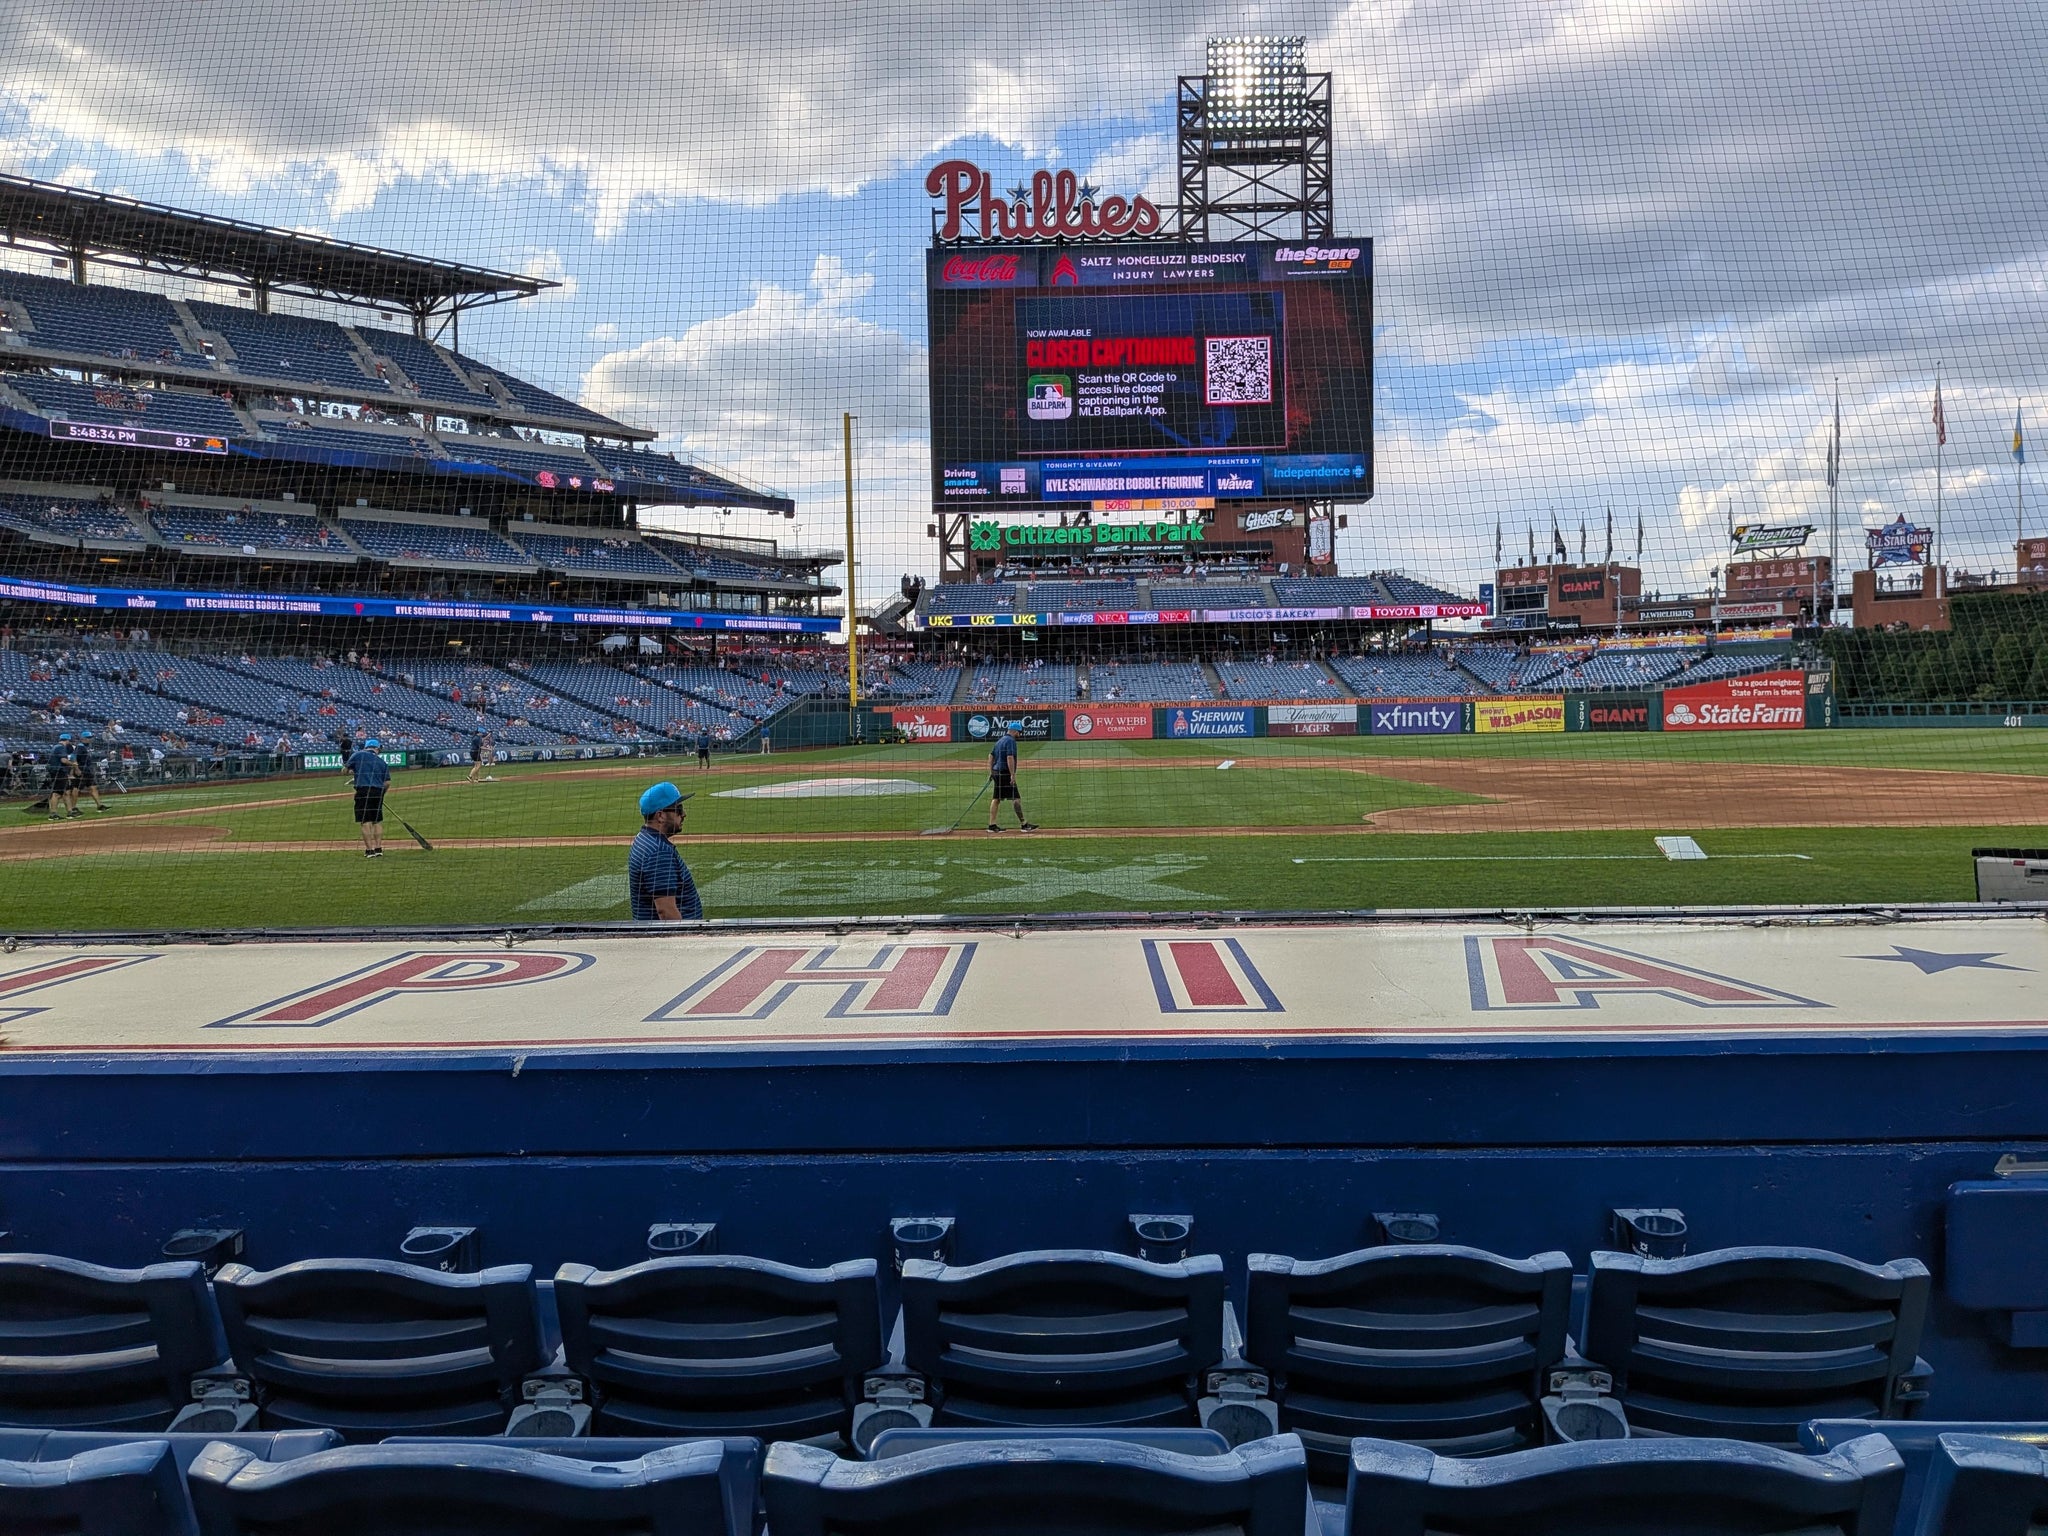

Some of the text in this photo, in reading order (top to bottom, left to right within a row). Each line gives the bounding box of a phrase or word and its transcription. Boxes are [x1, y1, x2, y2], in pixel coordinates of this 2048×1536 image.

[925, 159, 1161, 241] Phillies
[1275, 247, 1360, 261] theScore
[1080, 254, 1247, 266] SALTZ MONGELUZZI BENDESKY
[1112, 269, 1215, 280] INJURY LAWYERS
[1048, 329, 1091, 337] AVAILABLE
[1027, 337, 1196, 367] CLOSED CAPTIONING
[1078, 373, 1177, 383] Scan the QR Code to
[1113, 385, 1130, 394] live
[1132, 384, 1164, 393] closed
[1031, 401, 1067, 410] BALLPARK
[1078, 395, 1159, 408] captioning in the
[1079, 406, 1167, 417] MLB Ballpark App.
[70, 426, 116, 440] 5:48:34
[118, 431, 136, 442] PM
[944, 469, 976, 480] Driving
[1274, 467, 1350, 480] Independence
[944, 478, 979, 486] smarter
[1046, 476, 1204, 492] KYLE SCHWARBER BOBBLE FIGURINE
[1218, 477, 1254, 490] Wawa
[944, 487, 991, 495] outcomes.
[1246, 510, 1284, 531] GHOST
[1005, 520, 1204, 544] Citizens Bank Park
[1867, 534, 1931, 547] ALL STAR GAME
[1562, 581, 1600, 592] GIANT
[186, 598, 320, 612] KYLE SCHWARBER BOBBLE FIGURINE
[1441, 606, 1482, 615] TOYOTA
[396, 606, 510, 618] KYLE SCHWARBER BOBBLE FIGURINE
[1162, 612, 1189, 622] NECA
[1230, 610, 1316, 620] LISCIO'S BAKERY
[1374, 608, 1416, 616] TOYOTA
[574, 614, 588, 622] KYLE
[590, 614, 624, 622] SCHWARBER
[928, 616, 952, 626] UKG
[971, 615, 994, 625] UKG
[1013, 614, 1036, 624] UKG
[1097, 614, 1125, 622] NECA
[1556, 622, 1579, 630] Fanatics
[1751, 680, 1768, 688] good
[1808, 673, 1830, 695] MONTY'S ANGLE
[1732, 689, 1750, 697] State
[1190, 711, 1244, 722] SHERWIN
[1285, 706, 1340, 723] Yuengling
[1377, 706, 1456, 731] xfinity
[1590, 708, 1647, 723] GIANT
[1096, 717, 1146, 726] F.W. WEBB
[2004, 716, 2022, 727] 401
[1295, 724, 1330, 733] LAGER
